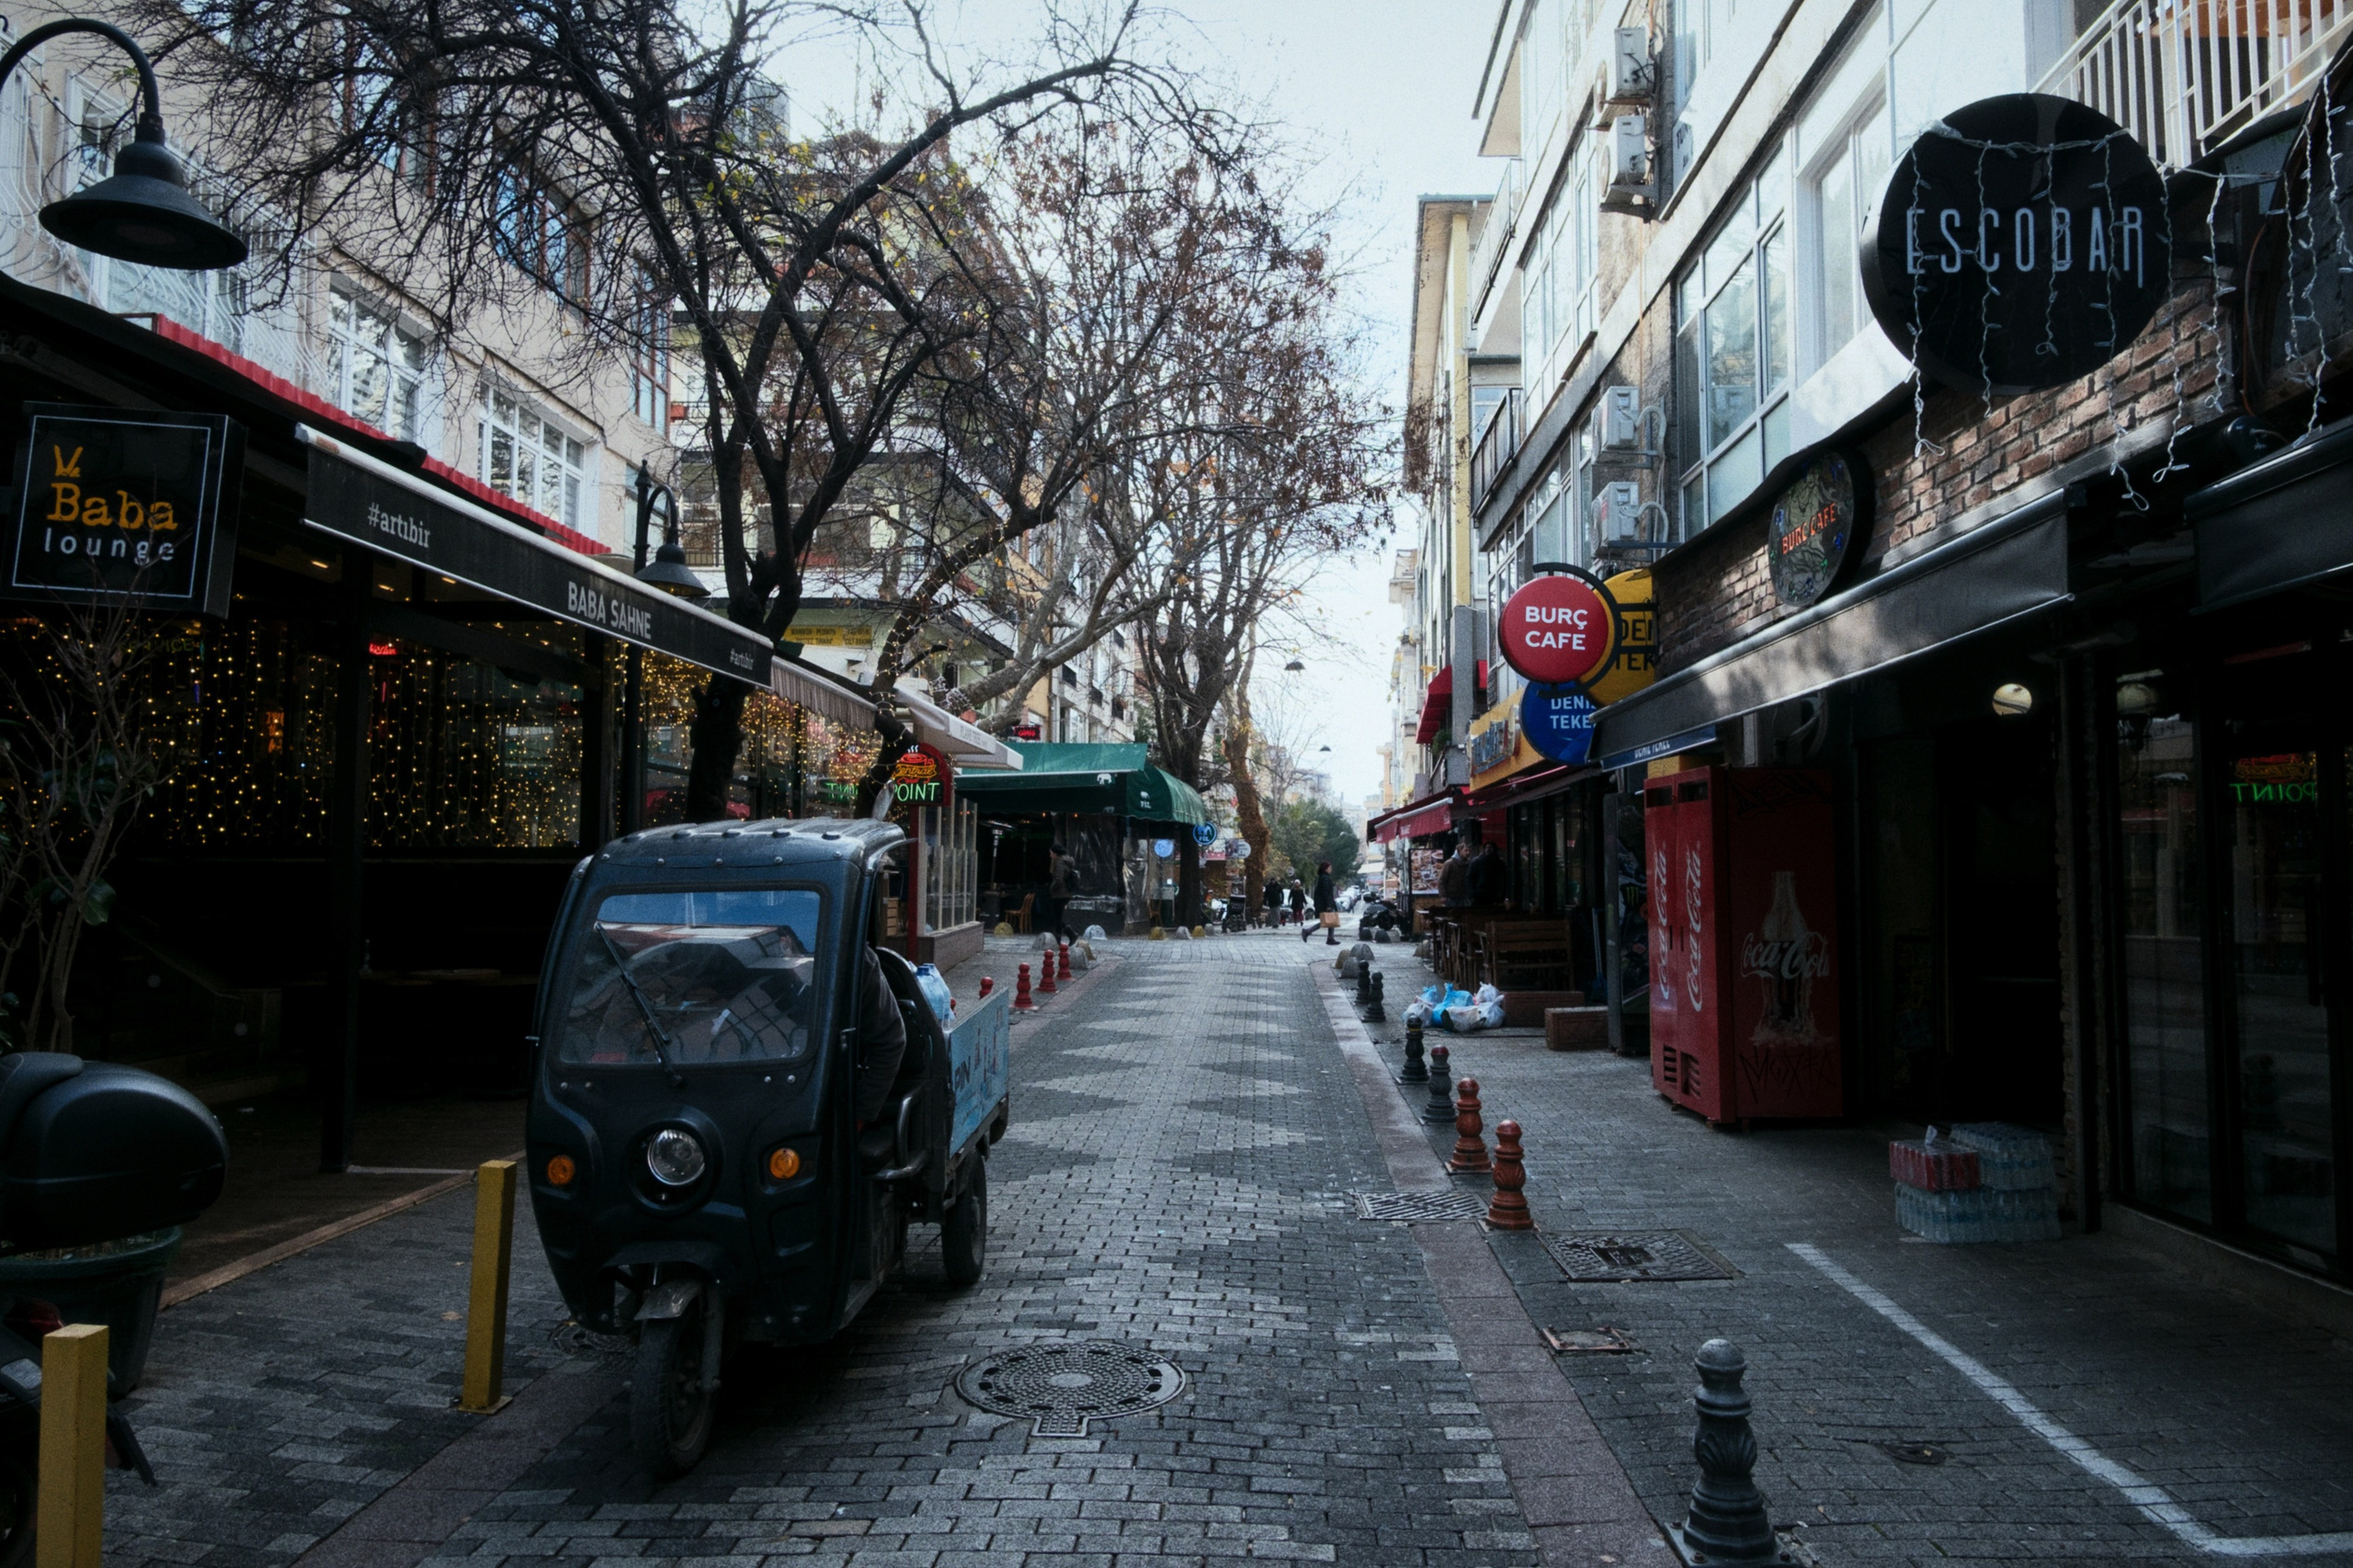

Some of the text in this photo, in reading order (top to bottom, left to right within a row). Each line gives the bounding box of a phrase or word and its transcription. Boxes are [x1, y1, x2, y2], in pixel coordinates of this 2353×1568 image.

[1906, 206, 2143, 288] ESCOBAR
[46, 483, 178, 530] Baba
[1810, 502, 1836, 536] CAFE
[44, 527, 174, 566] lounge
[568, 581, 652, 640] BABA SAHNE
[1525, 606, 1588, 630] BURÇ
[1525, 631, 1586, 651] CAFE
[1550, 715, 1596, 729] TEKE
